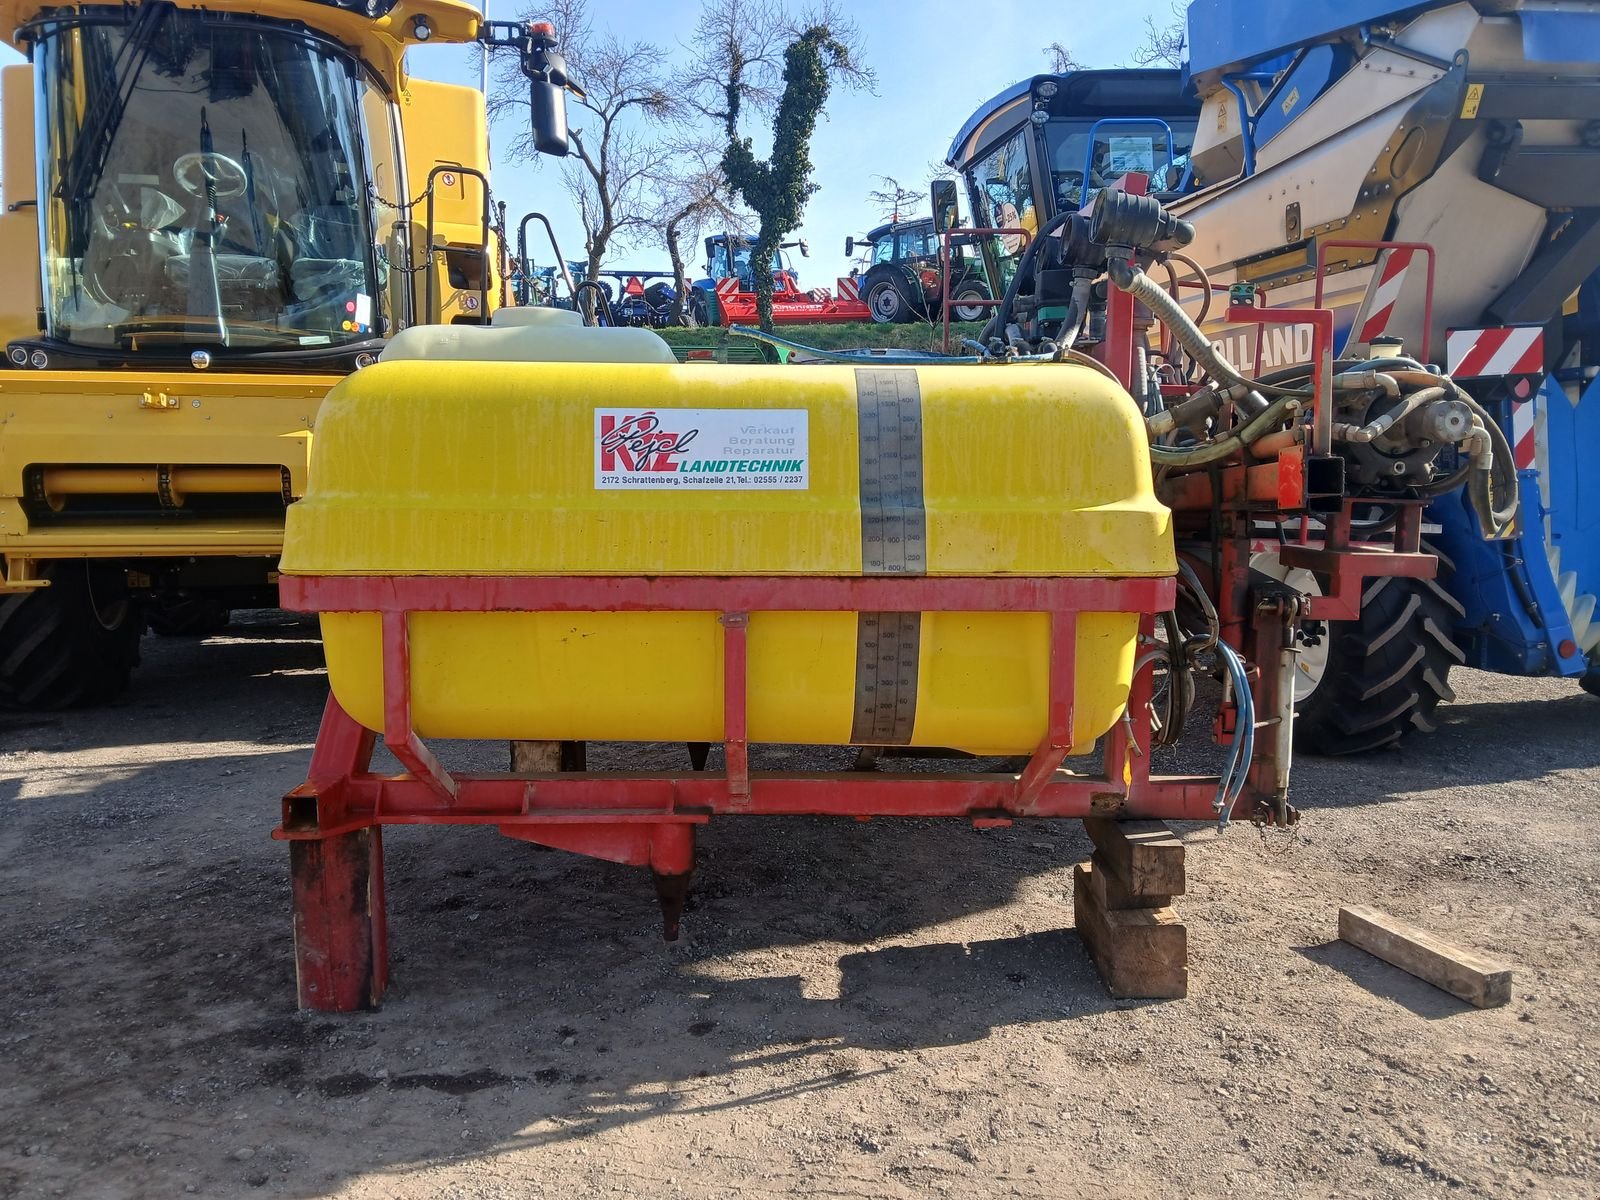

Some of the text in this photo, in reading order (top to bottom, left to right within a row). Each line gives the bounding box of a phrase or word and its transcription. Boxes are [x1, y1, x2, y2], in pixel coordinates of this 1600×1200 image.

[740, 426, 795, 434] Verkauf
[729, 437, 795, 446] Beratung
[723, 447, 795, 456] Reparatur
[680, 459, 804, 472] LANDTECHNIK
[602, 476, 620, 484] 2172
[622, 476, 681, 486] Schrattenberg,
[683, 476, 724, 484] Schafzeile
[753, 476, 777, 484] 02555
[784, 476, 803, 484] 2237
